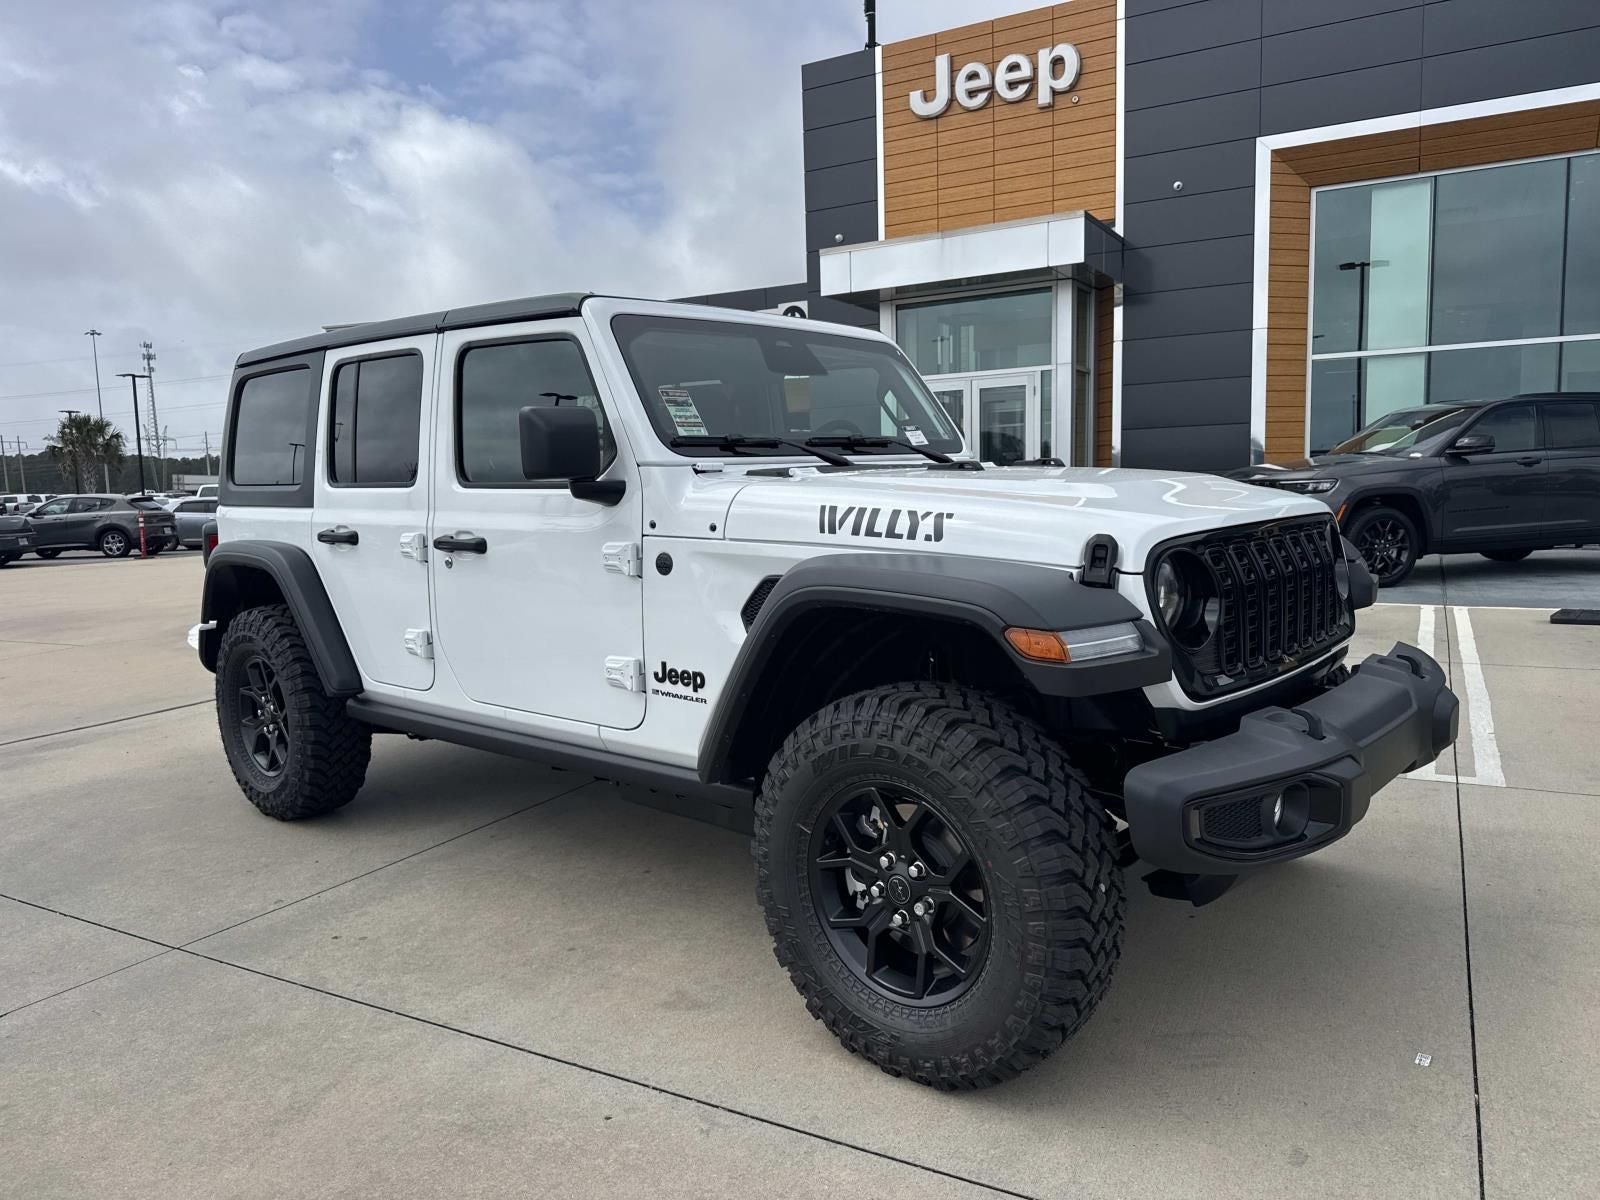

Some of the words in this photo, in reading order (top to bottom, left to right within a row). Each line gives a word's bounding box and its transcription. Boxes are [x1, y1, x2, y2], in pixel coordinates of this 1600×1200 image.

[909, 43, 1081, 119] Jeep
[819, 504, 955, 543] WILLYS
[653, 660, 706, 693] Jeep
[659, 689, 708, 705] WRANGLER
